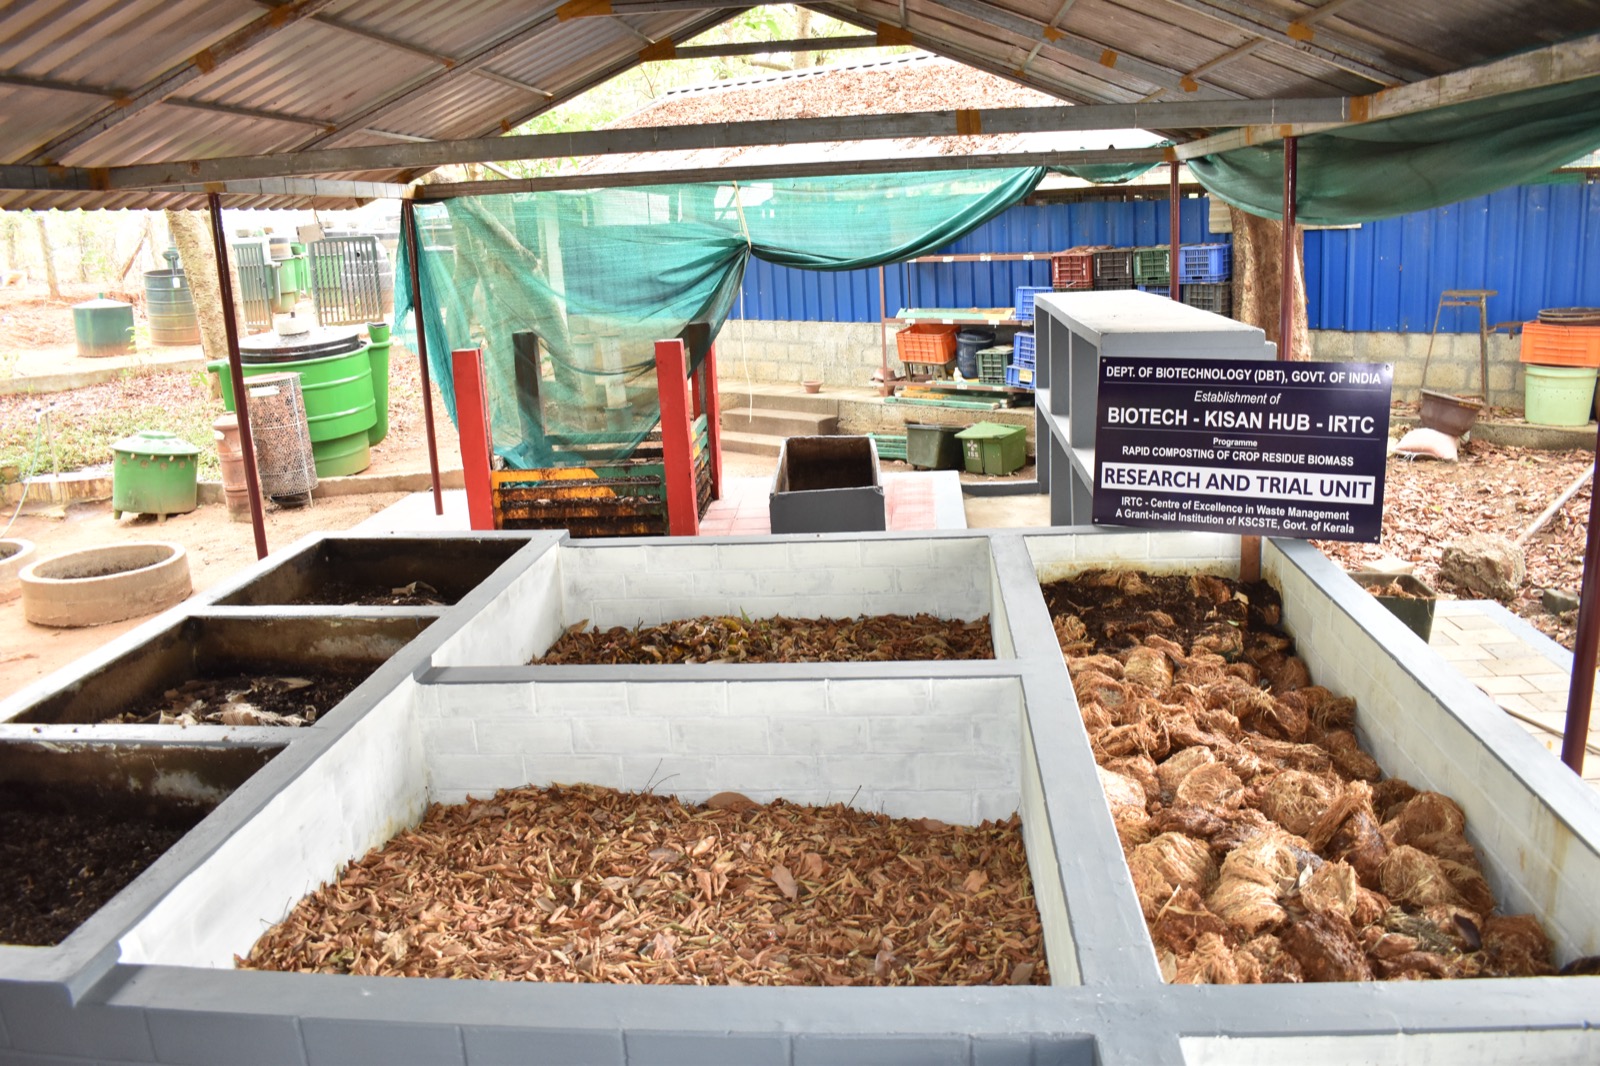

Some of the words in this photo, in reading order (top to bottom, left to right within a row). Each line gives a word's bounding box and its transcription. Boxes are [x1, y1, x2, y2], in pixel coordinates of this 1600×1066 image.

[1106, 366, 1135, 377] DEPT.
[1138, 366, 1153, 378] OF
[1155, 367, 1252, 380] BIOTECHNOLOGY
[1254, 369, 1288, 384] (DBT),
[1291, 370, 1325, 383] GOVT.
[1329, 371, 1345, 383] OF
[1348, 372, 1381, 384] INDIA
[1194, 390, 1267, 404] Establishment
[1269, 392, 1281, 405] of
[1107, 407, 1187, 426] BIOTECH
[1204, 410, 1262, 429] KISAN
[1268, 412, 1310, 431] HUB
[1328, 414, 1374, 434] IRTC
[1213, 437, 1257, 448] Programme
[1122, 445, 1150, 456] RAPID
[1152, 446, 1214, 459] COMPOSTING
[1217, 450, 1230, 460] OF
[1232, 450, 1260, 462] CROP
[1262, 452, 1305, 464] RESIDUE
[1307, 454, 1354, 466] BIOMASS
[1104, 467, 1200, 489] RESEARCH
[1205, 473, 1250, 491] AND
[1256, 476, 1313, 495] TRIAL
[1320, 479, 1372, 498] UNIT
[1121, 496, 1143, 506] IRTC
[1150, 498, 1180, 509] Centre
[1182, 500, 1192, 510] of
[1193, 500, 1243, 513] Excellence
[1245, 504, 1254, 514] in
[1256, 504, 1285, 516] Waste
[1287, 506, 1350, 521] Management
[1115, 508, 1123, 518] A
[1124, 508, 1176, 521] Grant-in-aid
[1178, 512, 1224, 525] Institution
[1226, 515, 1236, 525] of
[1238, 516, 1280, 530] KSCSTE,
[1282, 519, 1308, 531] Govt.
[1310, 520, 1321, 531] of
[1323, 522, 1355, 534] Kerala
